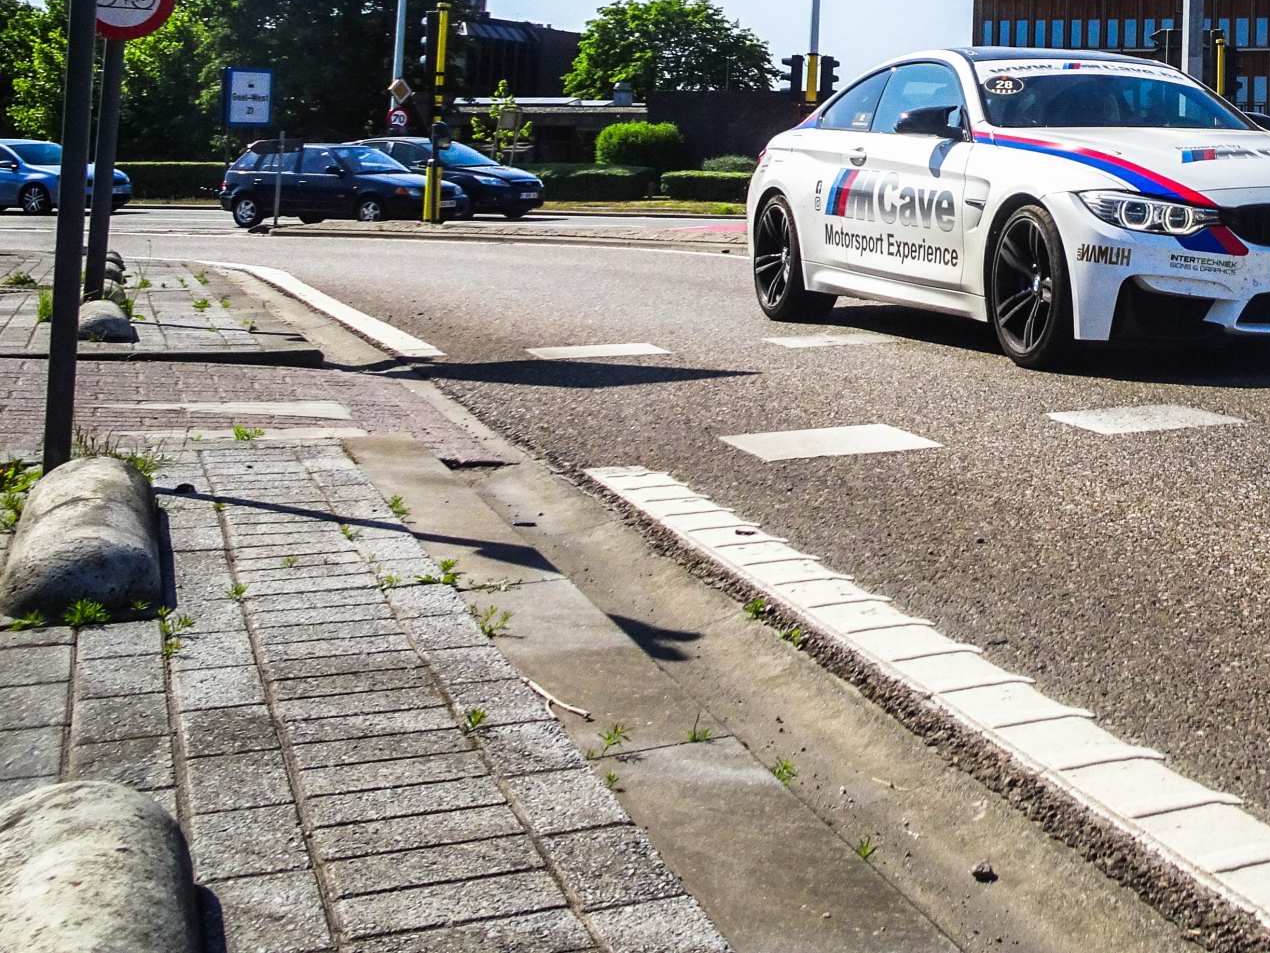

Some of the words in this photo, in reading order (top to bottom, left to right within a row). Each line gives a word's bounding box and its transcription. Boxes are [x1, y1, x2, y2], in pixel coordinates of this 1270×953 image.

[995, 80, 1013, 89] 28
[392, 113, 405, 124] 70
[825, 223, 884, 257] Motorsport
[887, 233, 959, 267] Experience
[1170, 253, 1239, 268] INTERTECHNIEK
[1169, 261, 1192, 271] SIGNS
[1200, 265, 1237, 276] GRAPHICS
